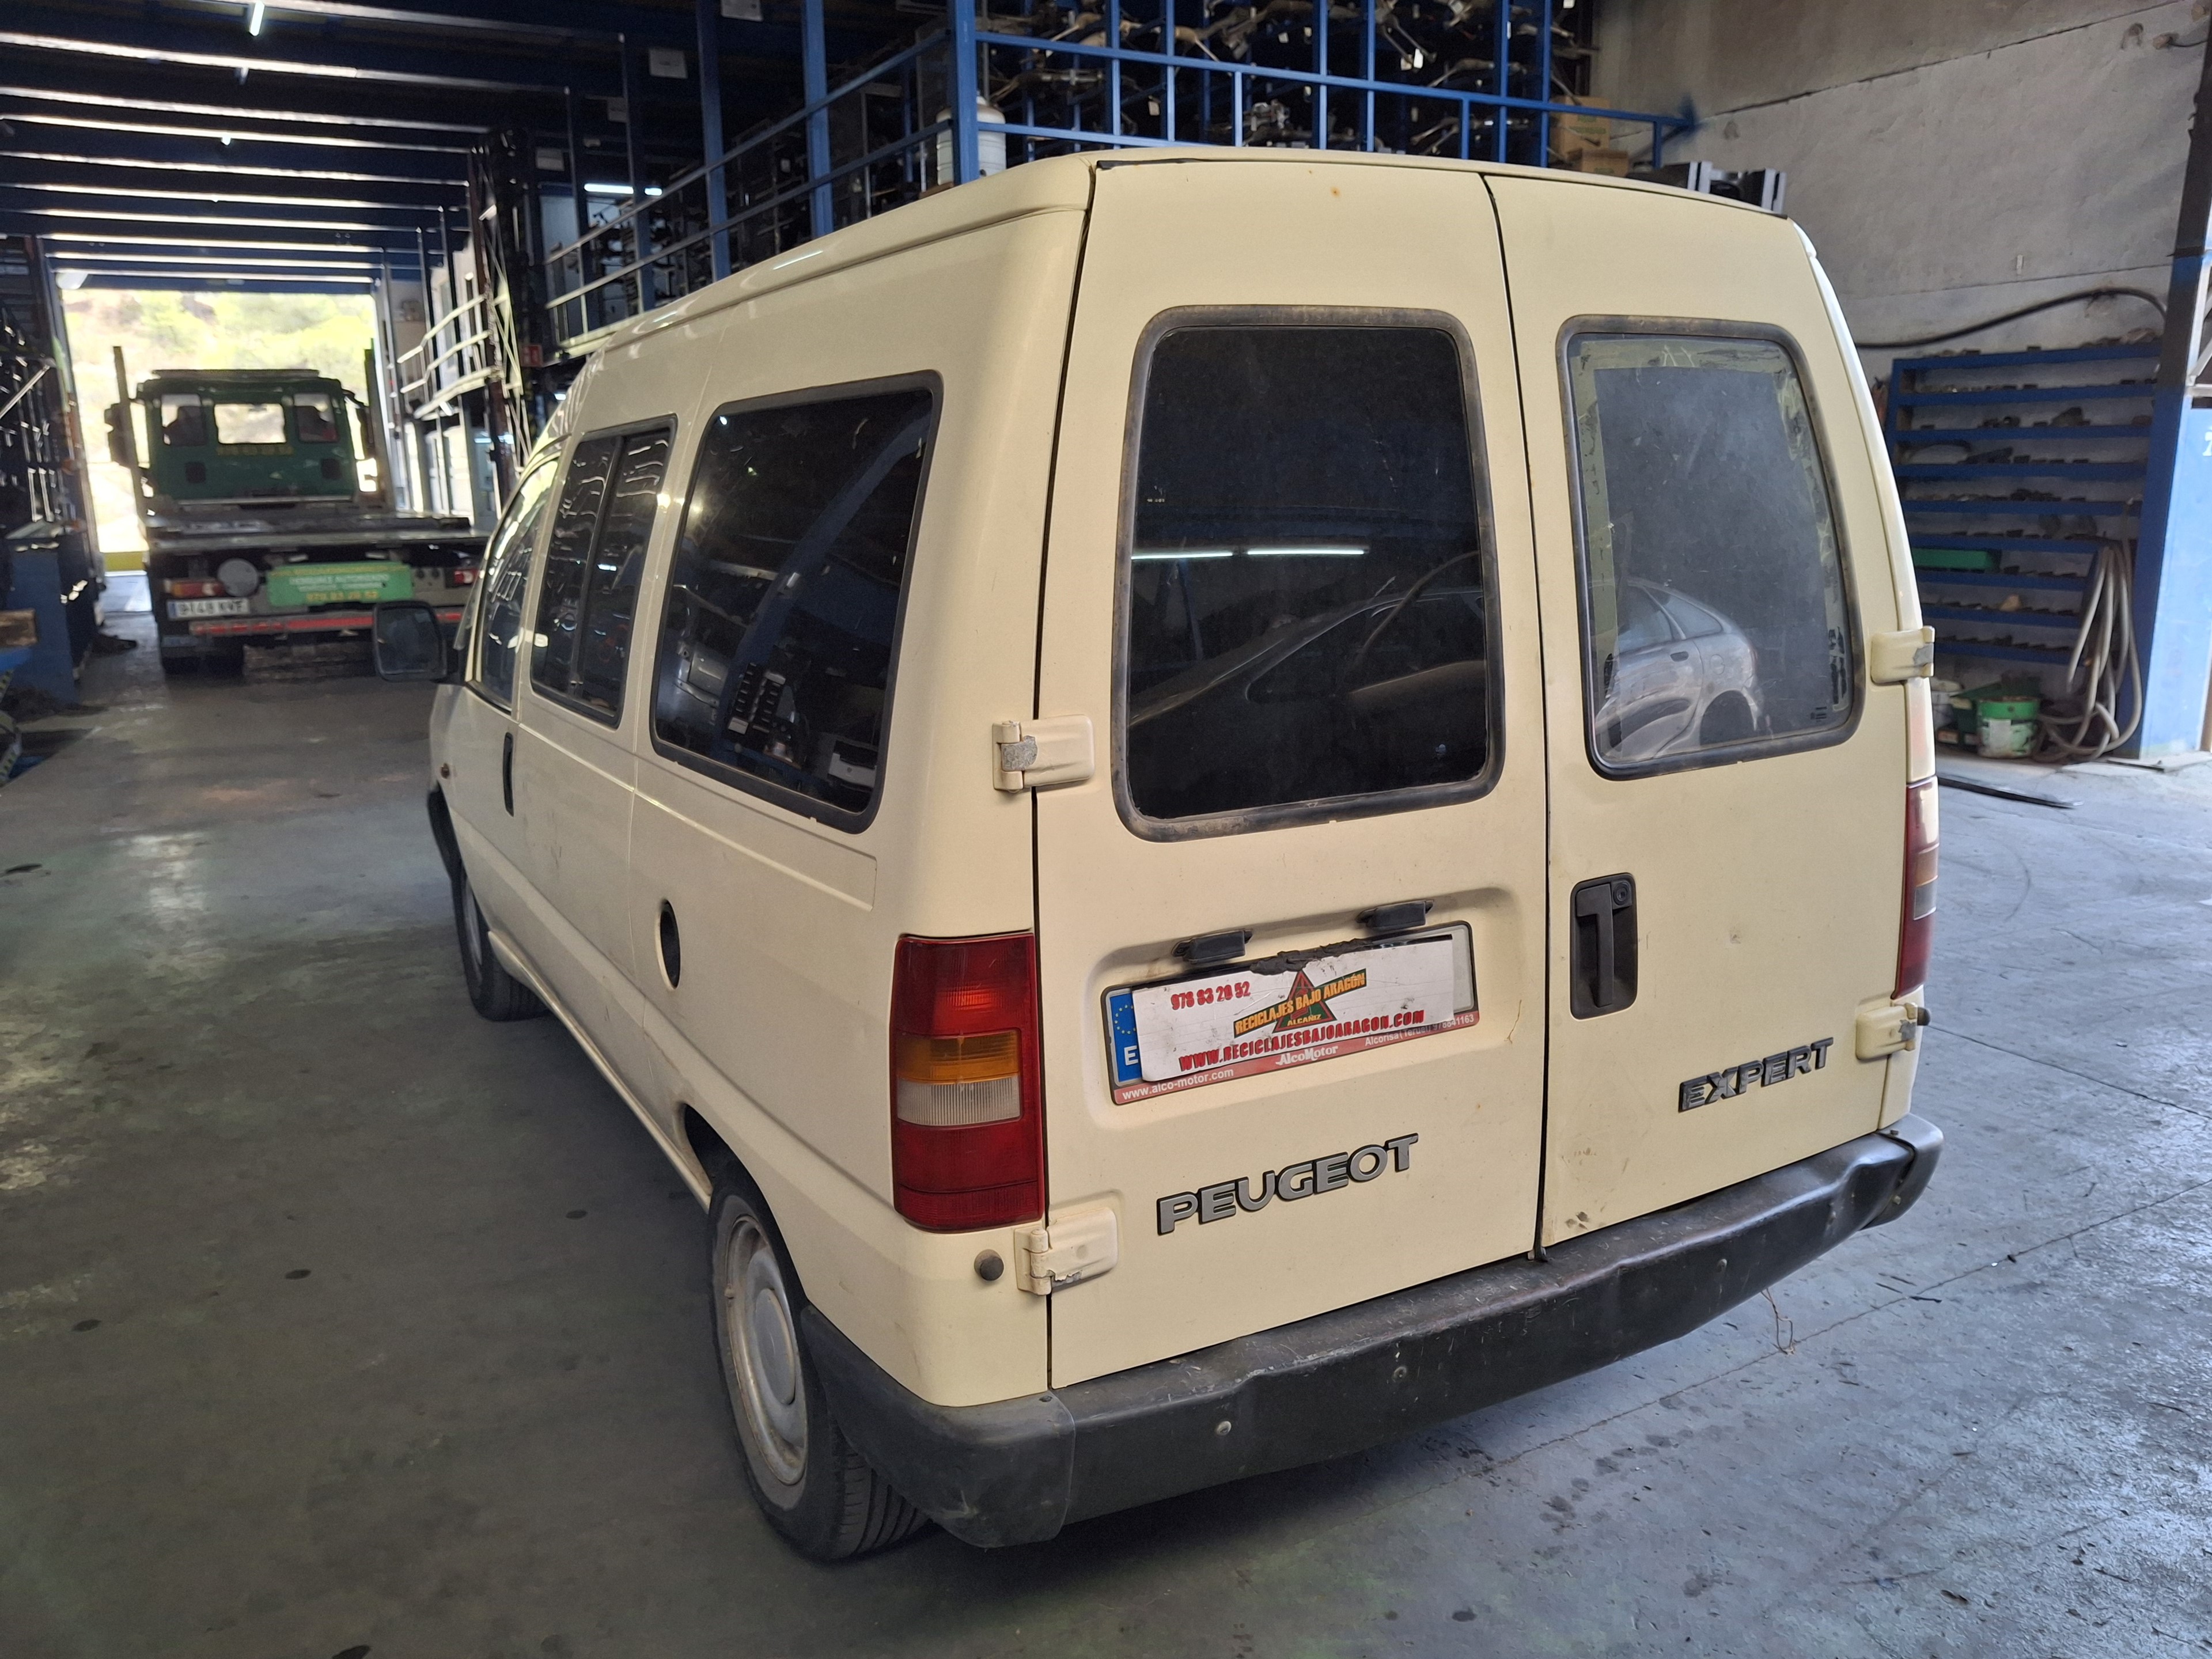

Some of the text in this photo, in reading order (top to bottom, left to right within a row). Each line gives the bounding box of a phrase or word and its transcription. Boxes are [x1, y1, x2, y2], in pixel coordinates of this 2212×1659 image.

[1171, 981, 1251, 1010] 978 83 20 52
[1235, 972, 1366, 1035] RECICLAJES BAJO ARAGÓN
[1124, 1045, 1139, 1066] E
[1178, 1009, 1425, 1071] WWW.RECICLAJESBAJOARAGON.COM
[1275, 1046, 1339, 1066] AlcoMotor
[1122, 1069, 1234, 1100] www.alco-motor.com
[1678, 1037, 1834, 1113] EXPERT
[1157, 1132, 1419, 1236] PEUGEOT
